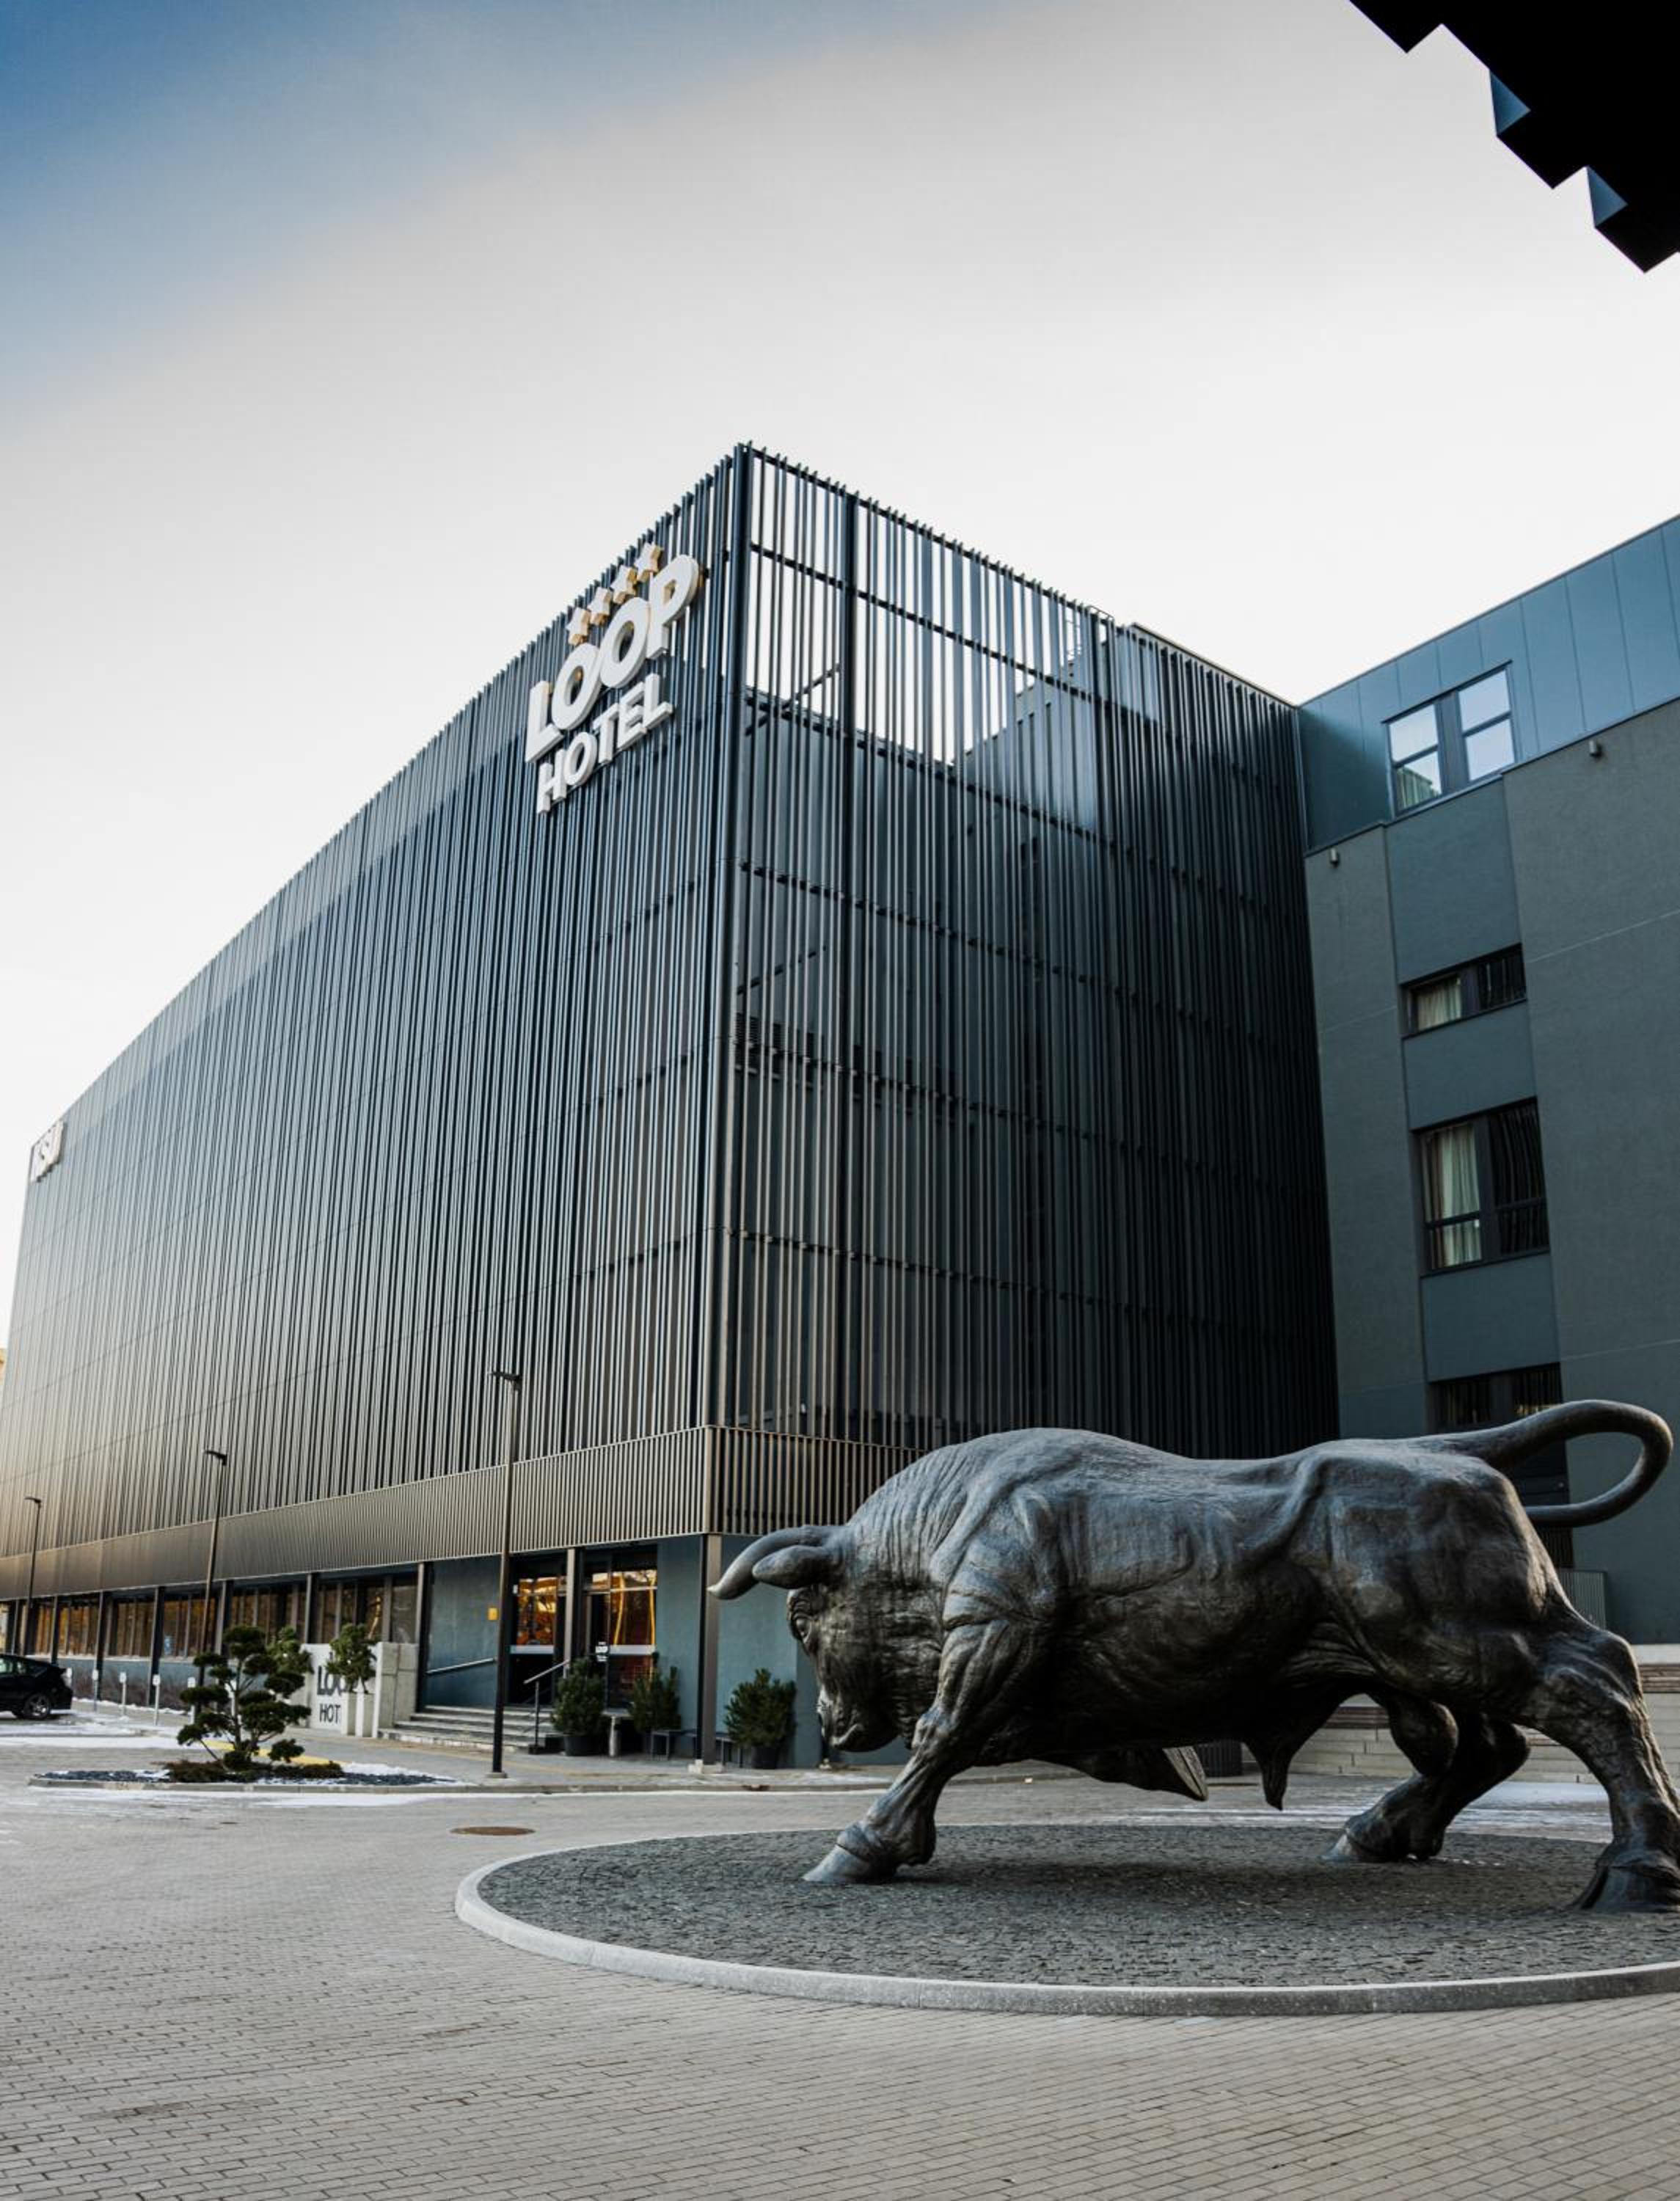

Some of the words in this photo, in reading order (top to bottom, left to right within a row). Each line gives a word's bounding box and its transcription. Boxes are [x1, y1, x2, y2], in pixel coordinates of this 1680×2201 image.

[525, 554, 700, 763] LOOP
[537, 673, 673, 814] HOTEL
[319, 1704, 341, 1724] HOT
